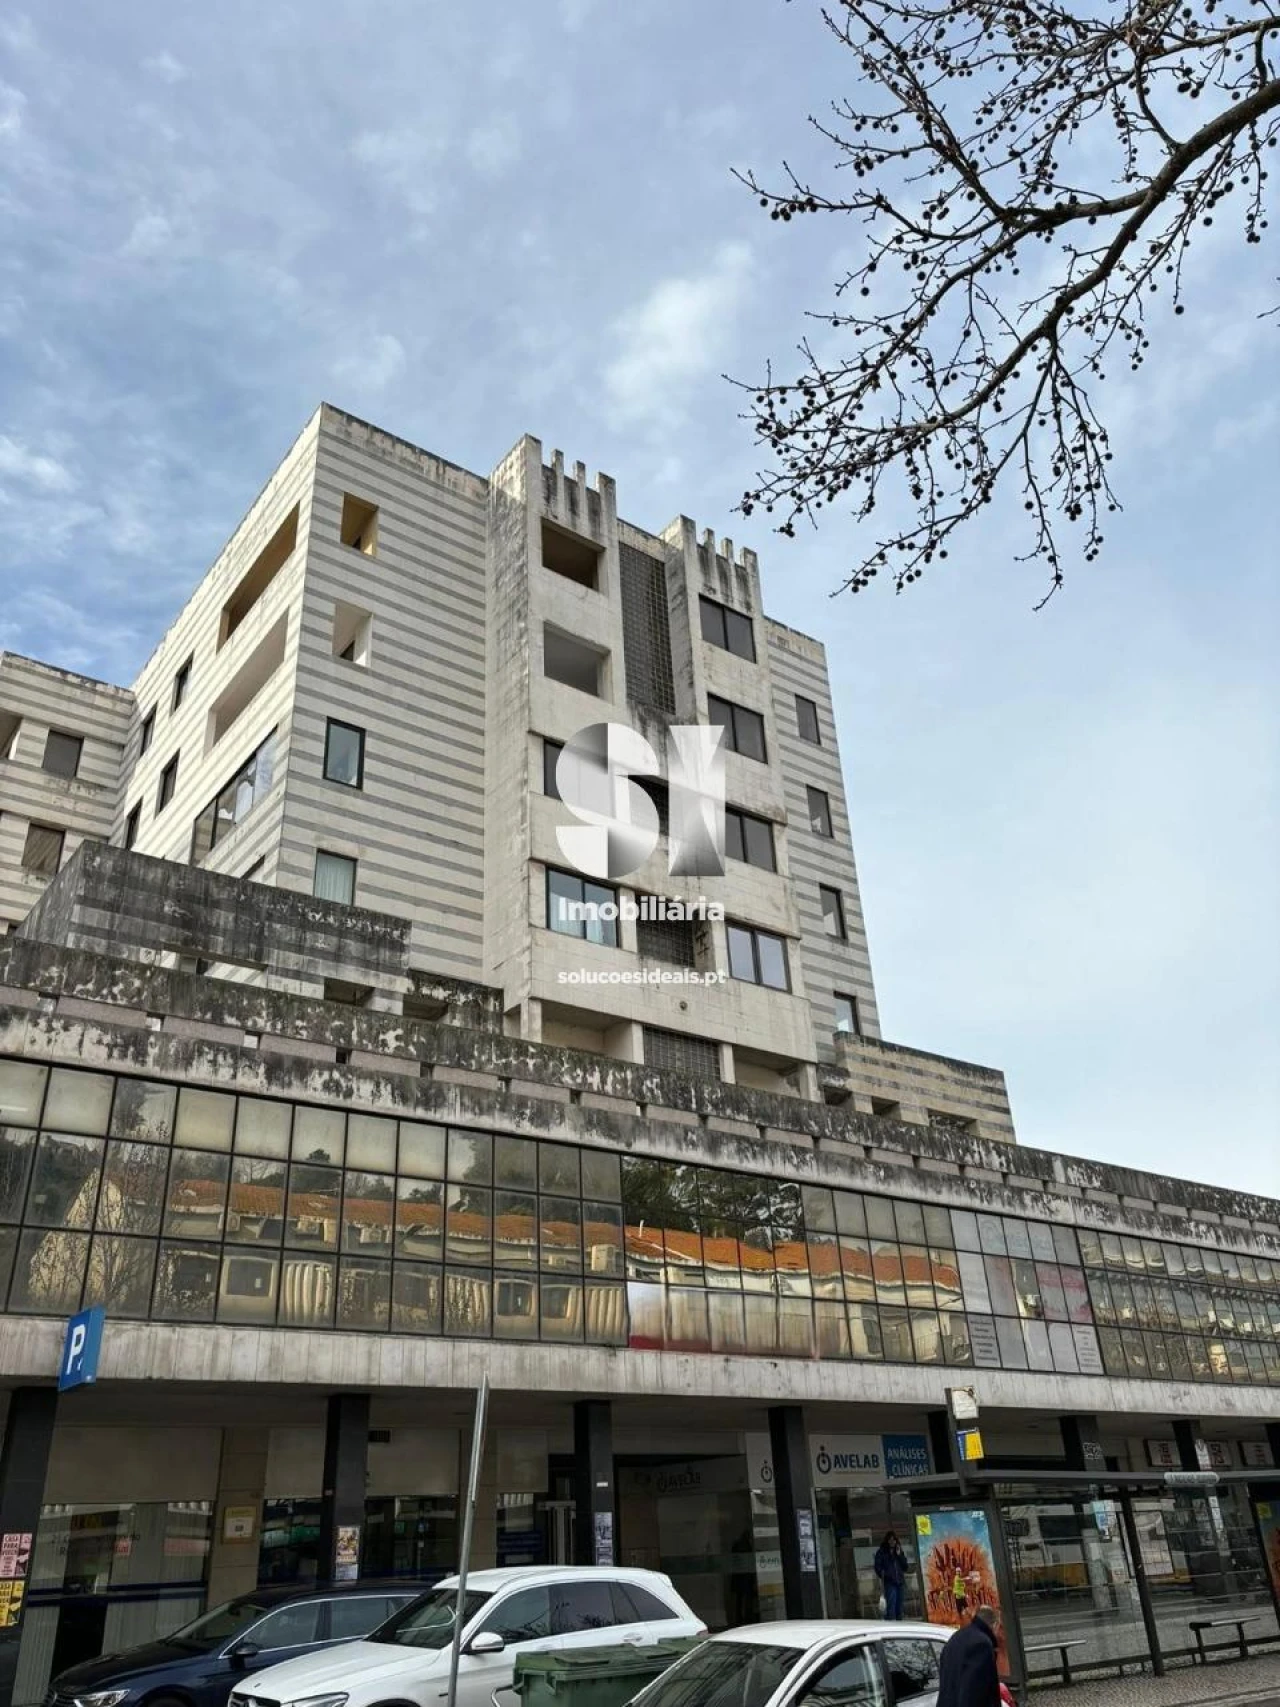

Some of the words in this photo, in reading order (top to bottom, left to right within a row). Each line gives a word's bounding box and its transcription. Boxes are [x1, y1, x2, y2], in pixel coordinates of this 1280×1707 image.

[66, 1324, 86, 1375] P
[887, 1446, 927, 1460] ANÁLISES
[834, 1454, 880, 1469] AVELAB
[892, 1460, 929, 1476] CLÍNICAS
